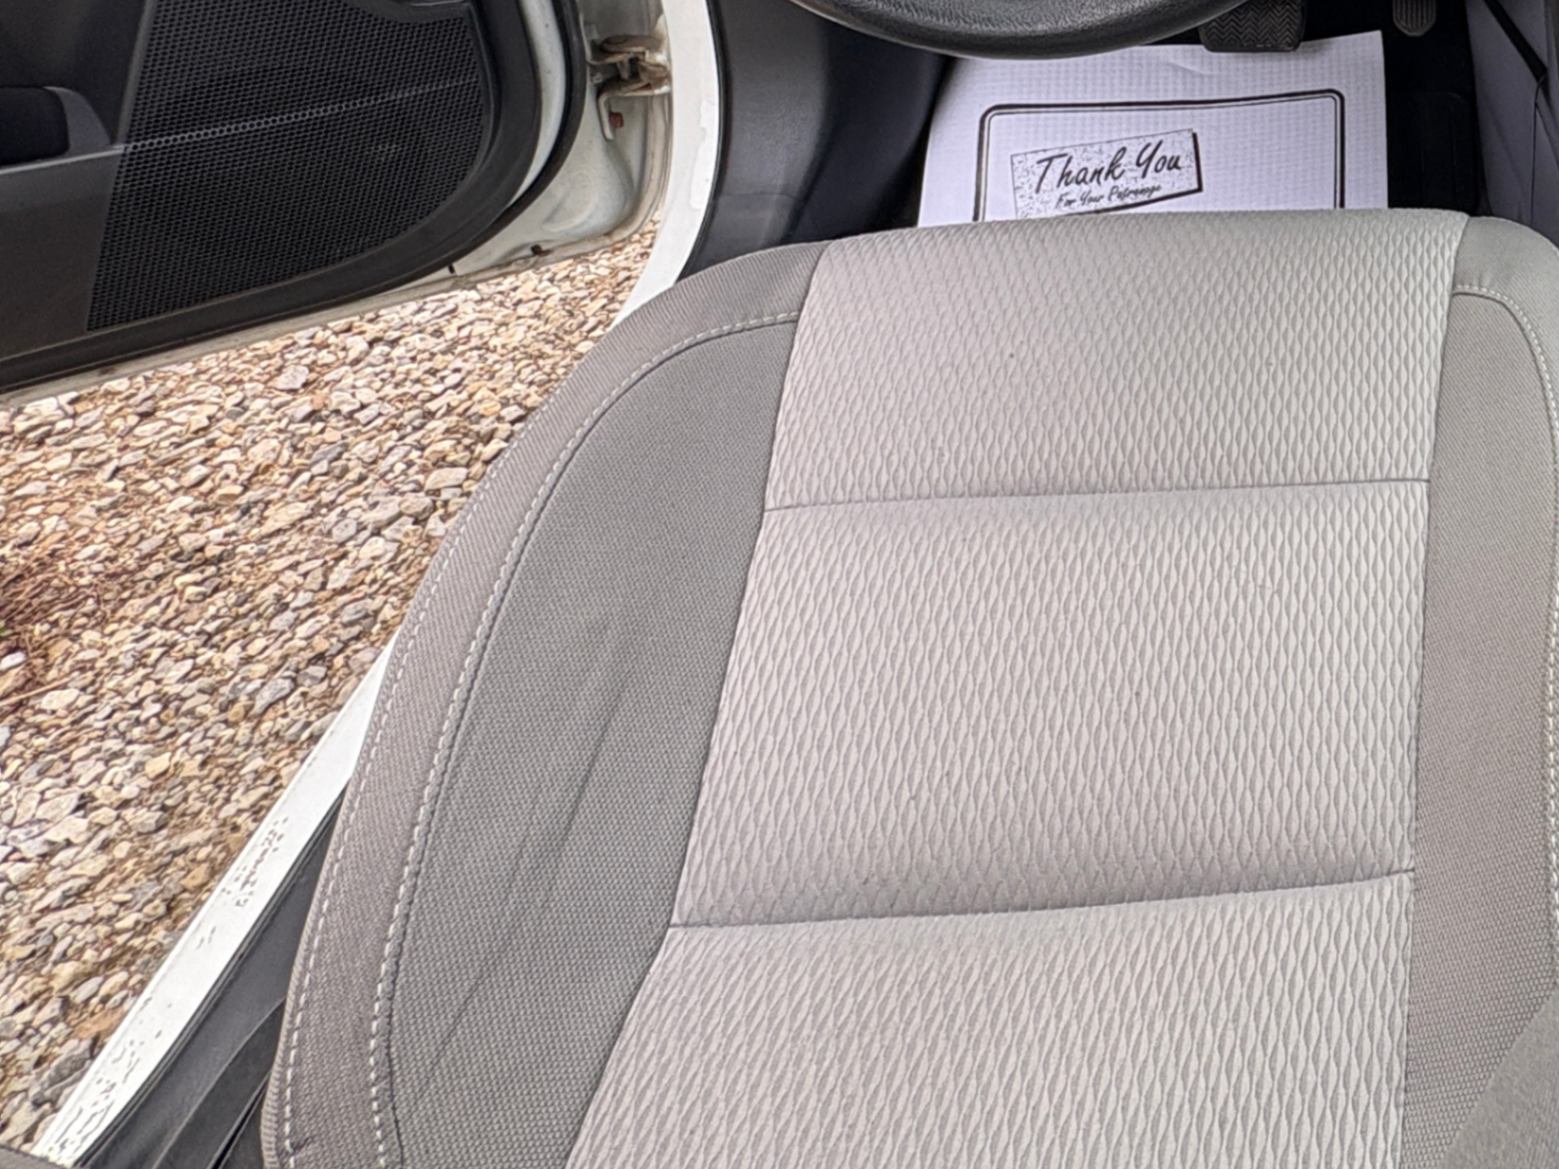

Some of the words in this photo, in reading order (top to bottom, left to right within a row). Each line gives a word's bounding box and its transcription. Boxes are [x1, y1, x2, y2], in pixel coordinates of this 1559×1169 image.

[1034, 146, 1128, 195] Thank
[1135, 139, 1182, 179] You
[1055, 193, 1077, 208] For
[1079, 190, 1104, 207] Your
